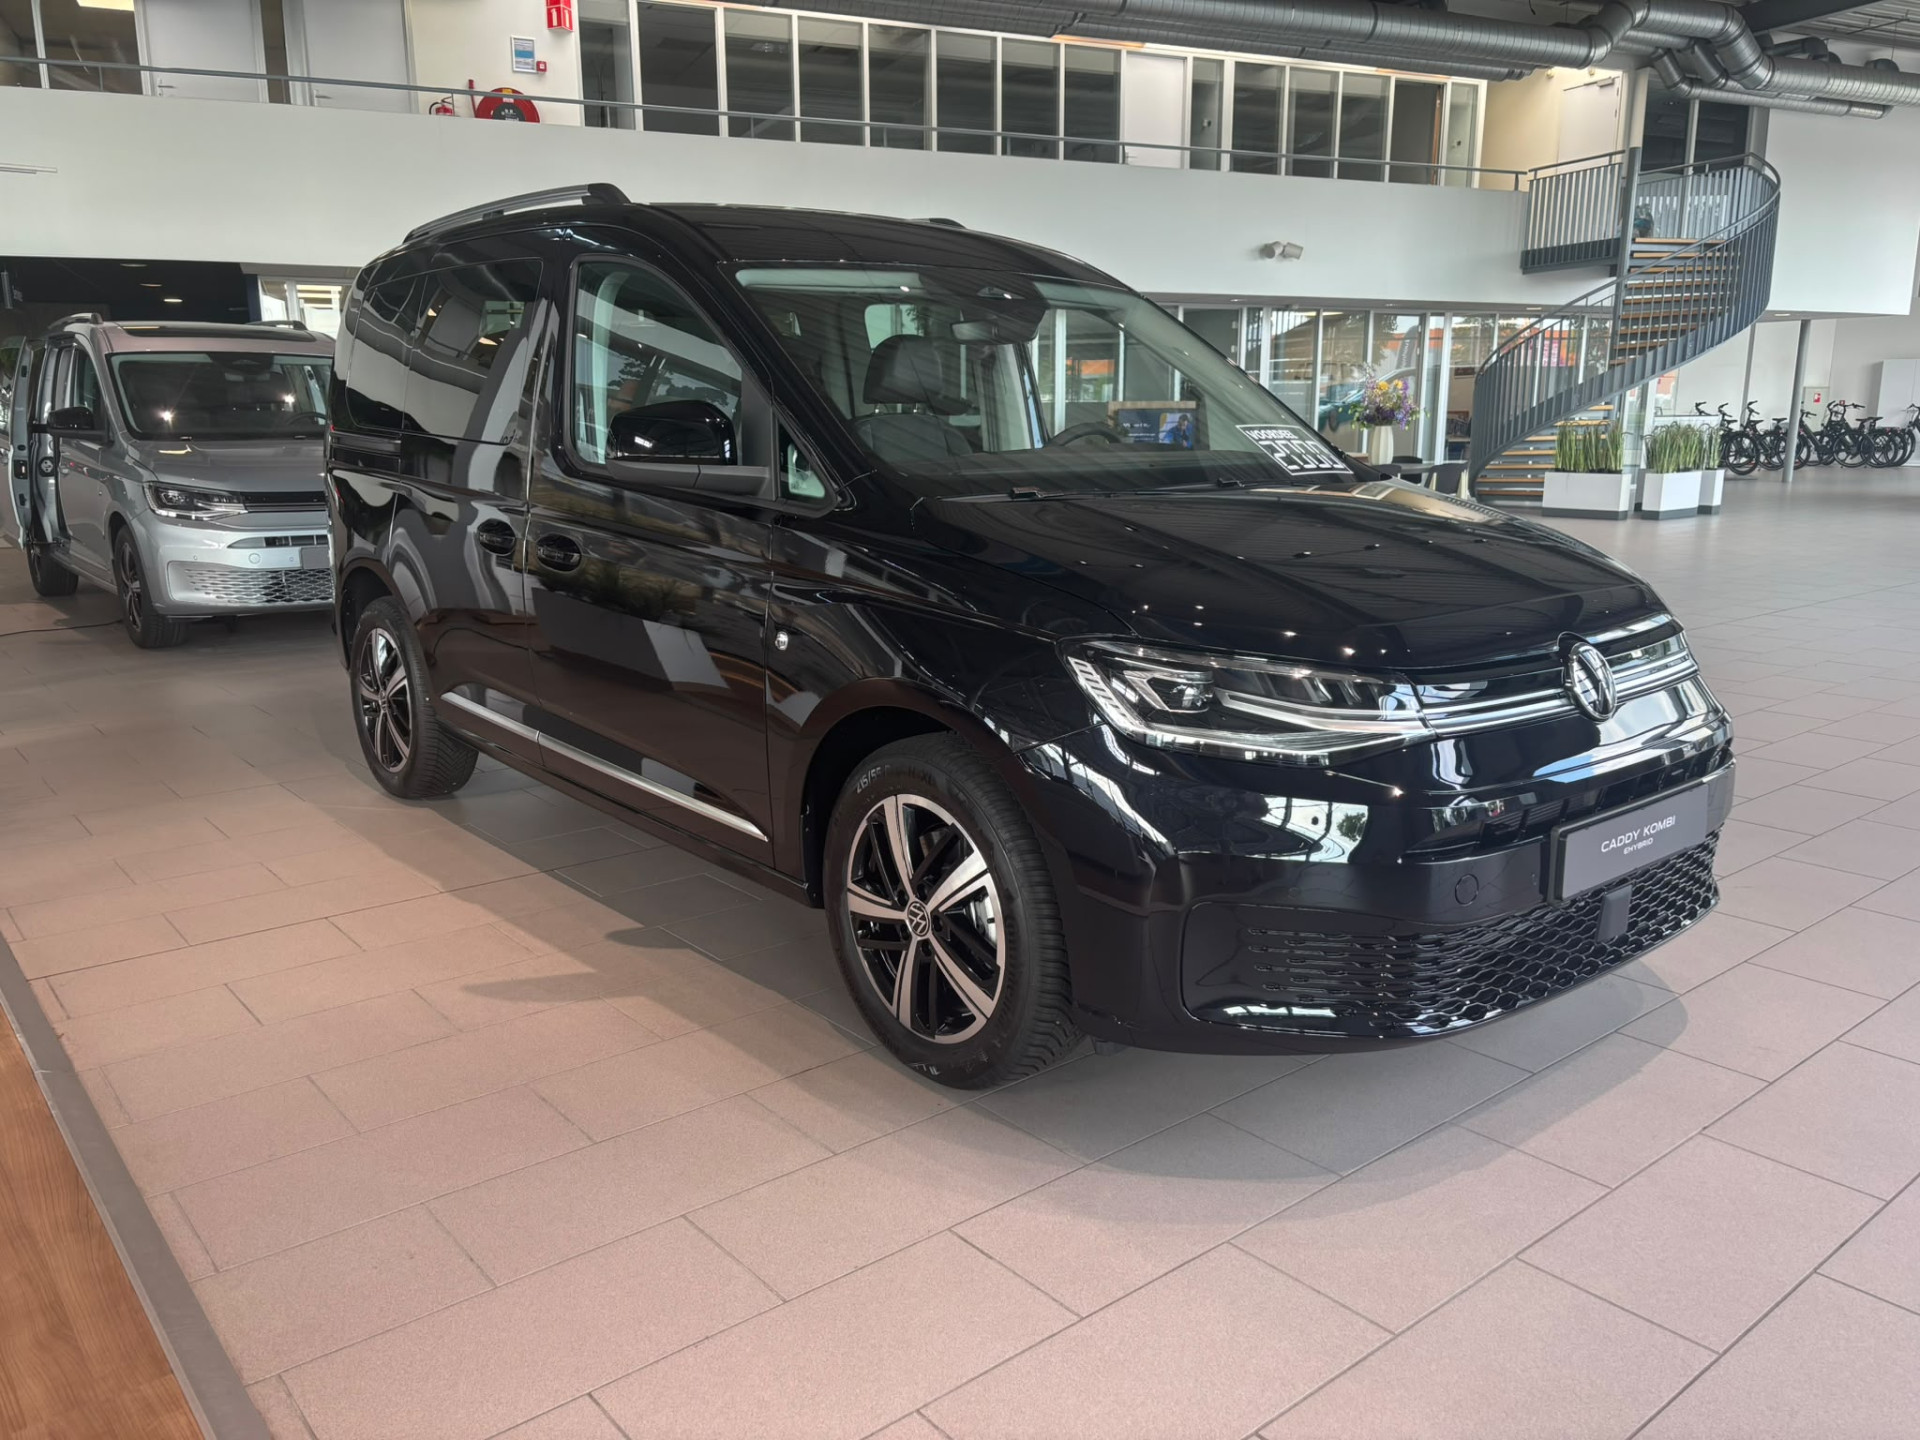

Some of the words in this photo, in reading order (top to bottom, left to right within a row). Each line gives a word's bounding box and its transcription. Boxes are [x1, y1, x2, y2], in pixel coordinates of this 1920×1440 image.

[1245, 429, 1299, 440] VOORDEEL
[1601, 829, 1640, 853] CADDY
[1643, 815, 1676, 836] KOMBI
